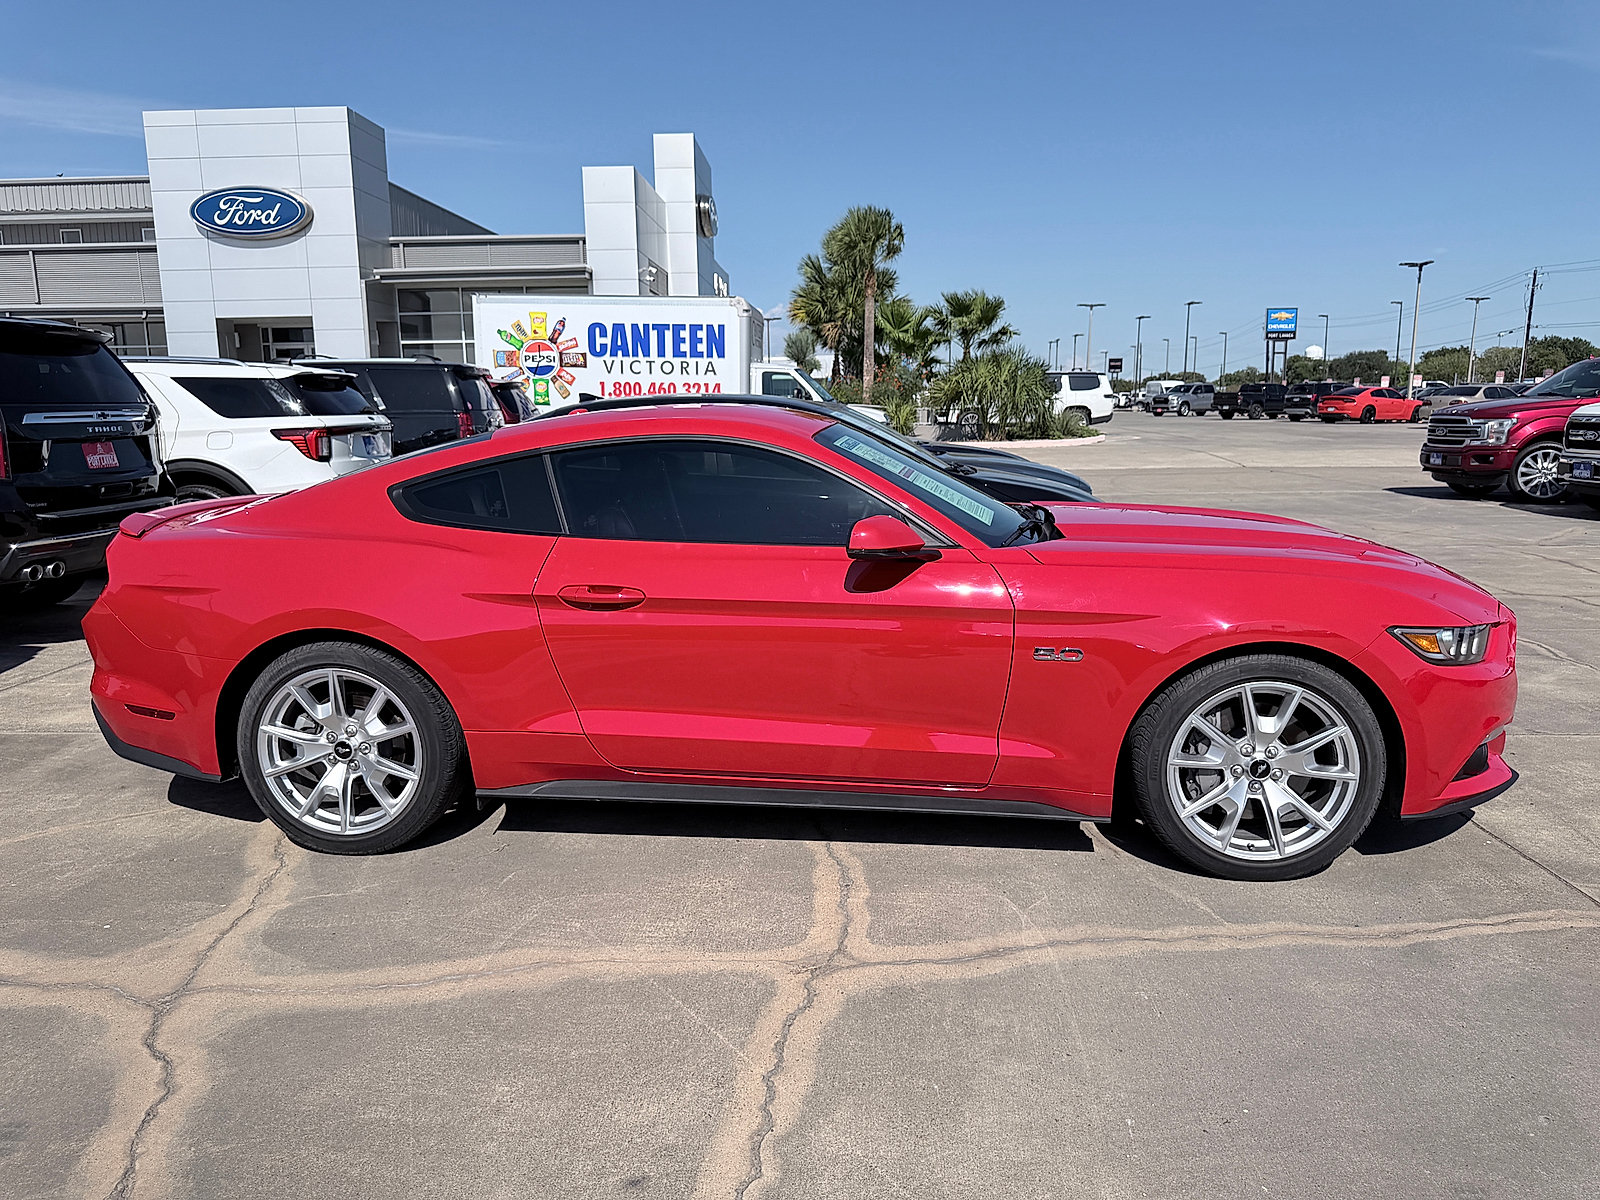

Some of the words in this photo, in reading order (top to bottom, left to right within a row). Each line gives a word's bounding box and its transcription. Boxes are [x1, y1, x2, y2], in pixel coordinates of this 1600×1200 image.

[213, 196, 281, 225] Ford
[587, 322, 726, 359] CANTEEN
[524, 355, 556, 363] PEPSI
[603, 360, 717, 376] VICTORIA
[599, 381, 721, 397] 1.800.4603214
[1033, 646, 1084, 662] 5.0
